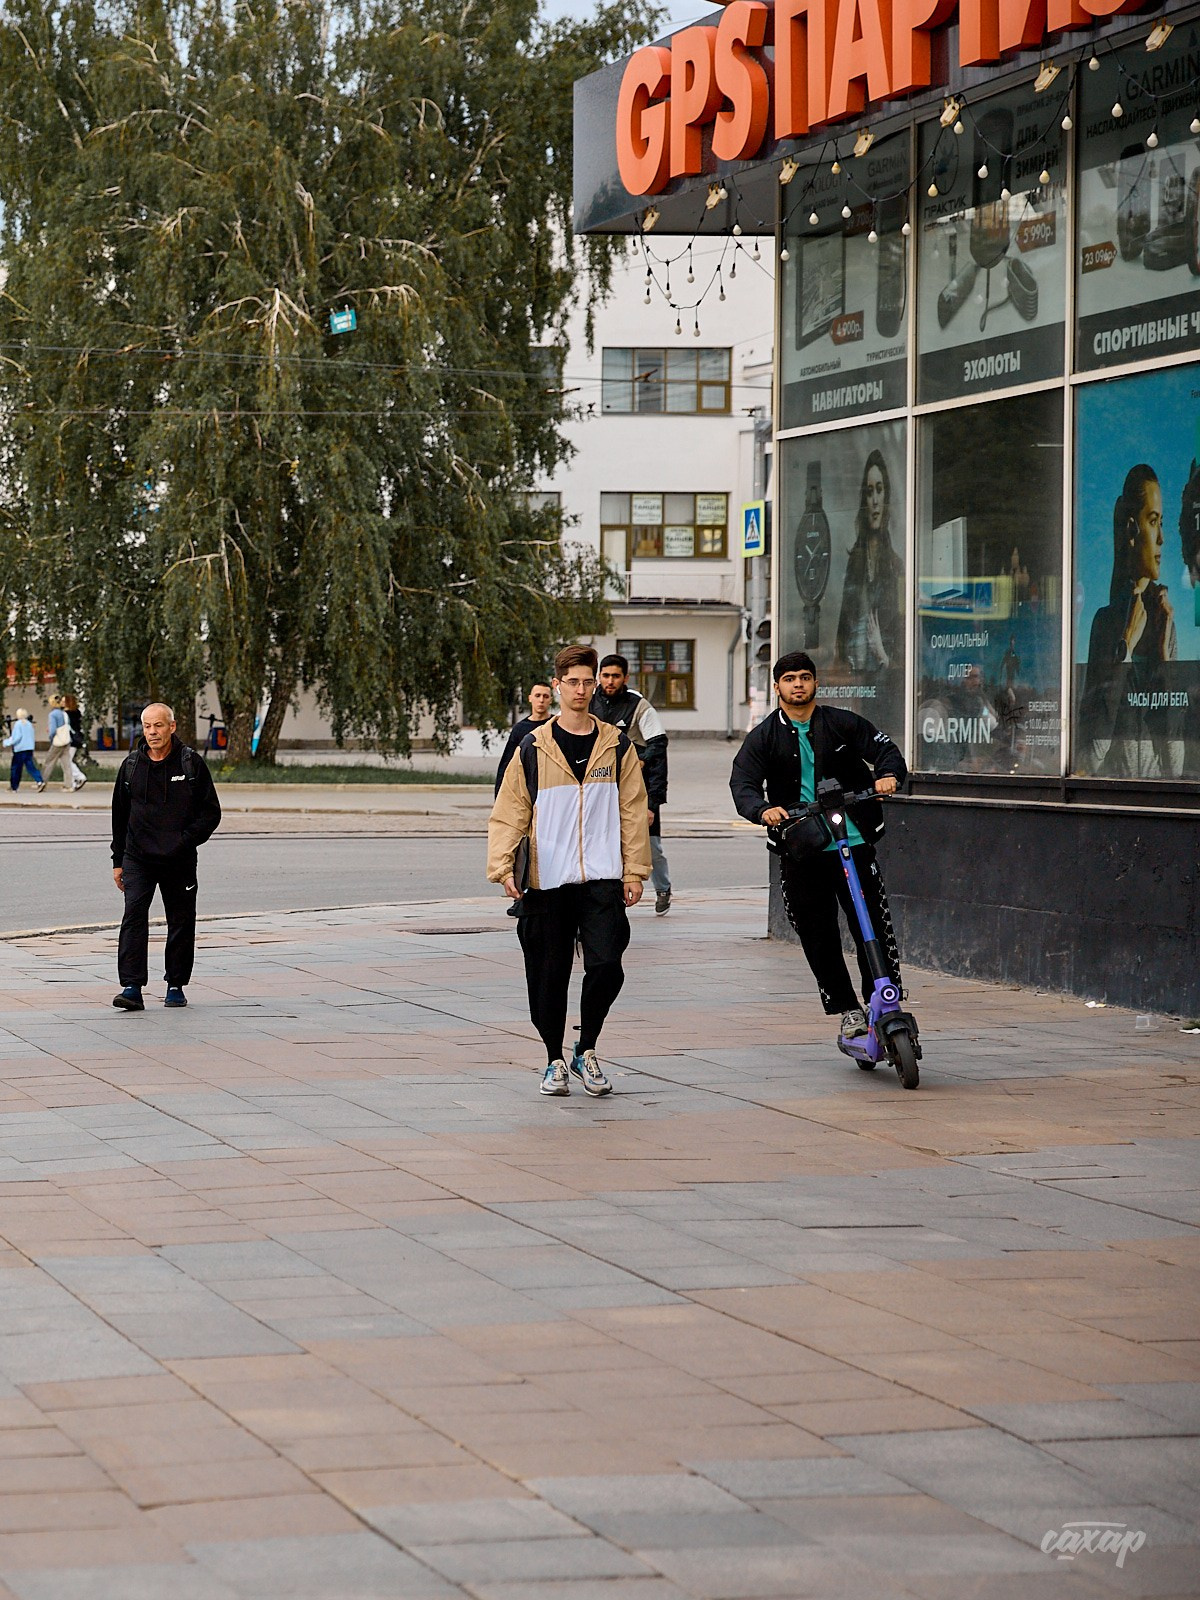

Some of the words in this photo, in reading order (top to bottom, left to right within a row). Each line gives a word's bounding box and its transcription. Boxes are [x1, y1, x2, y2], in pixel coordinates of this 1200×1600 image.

[924, 195, 966, 218] ПРАКТИК
[1093, 313, 1189, 355] СПОРТИВНЫЕ
[964, 350, 1020, 382] ЭХОЛОТЫ
[812, 380, 883, 412] НАВИГАТОРЫ
[931, 630, 989, 650] ОФИЦИАЛЬНЫЙ
[948, 663, 973, 680] ДИЛЕР
[1127, 692, 1150, 707] ЧАСЫ
[1150, 692, 1169, 710] ДЛЯ
[1170, 692, 1189, 707] БЕГА
[922, 717, 992, 744] GARMIN
